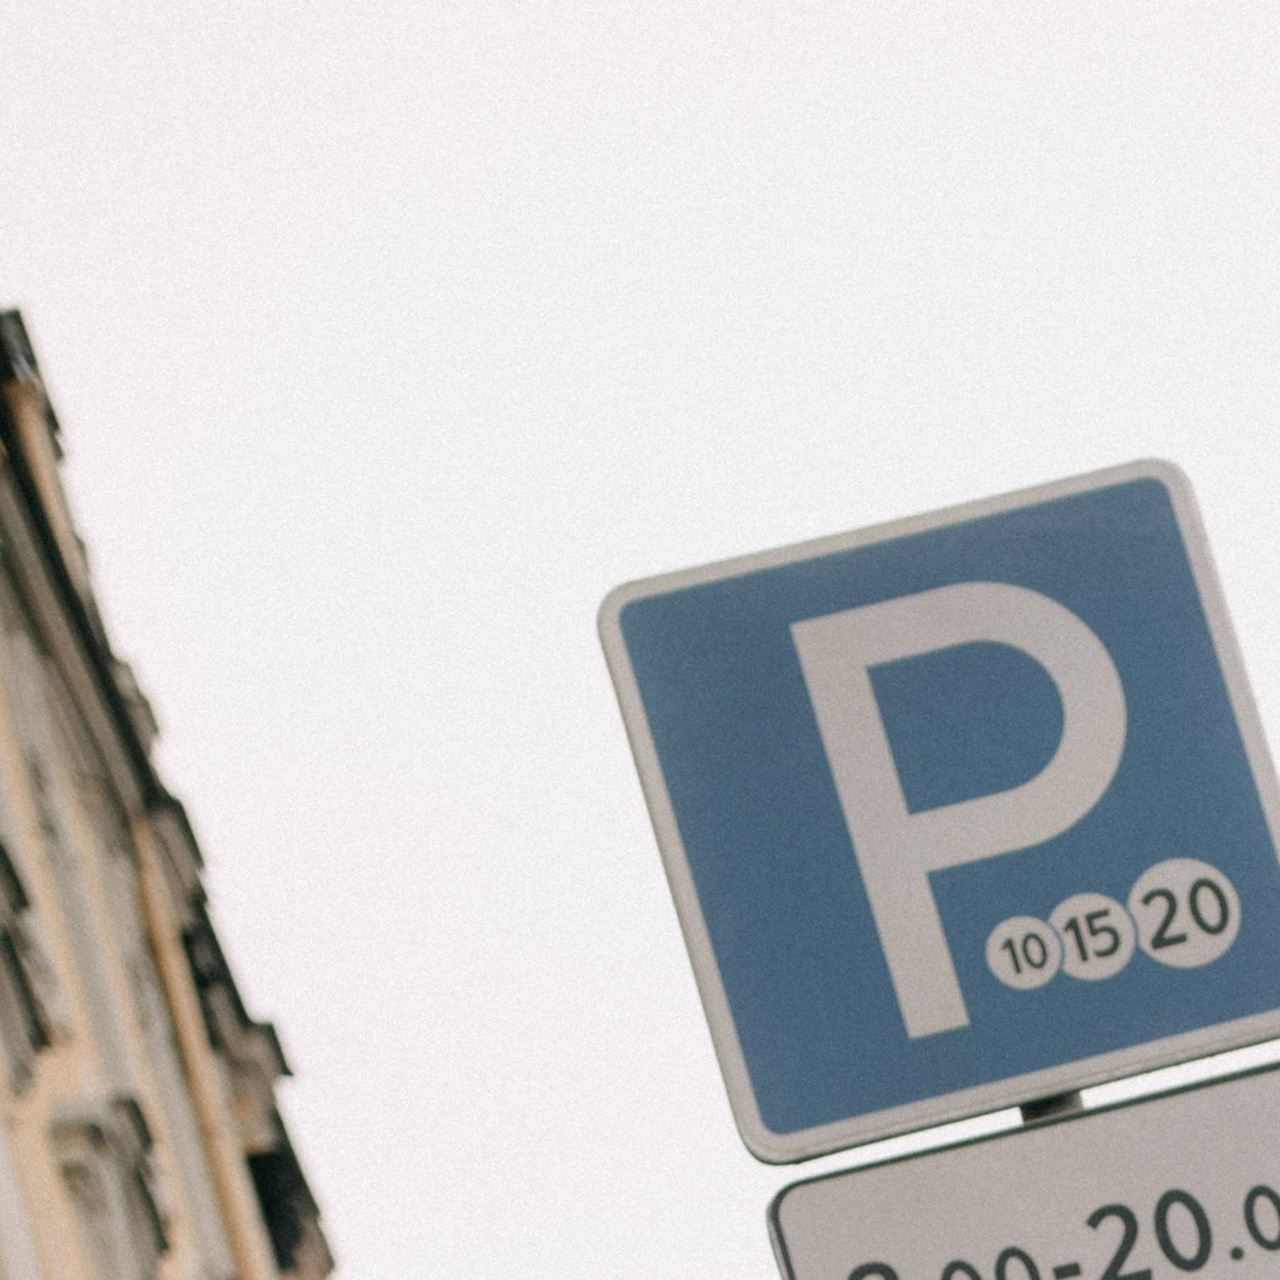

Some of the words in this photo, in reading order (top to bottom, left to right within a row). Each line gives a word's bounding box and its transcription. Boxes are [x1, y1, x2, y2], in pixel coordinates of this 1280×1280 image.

[788, 580, 1128, 1041] P
[1001, 931, 1050, 976] 10
[1062, 907, 1122, 964] 15
[1140, 876, 1231, 952] 20
